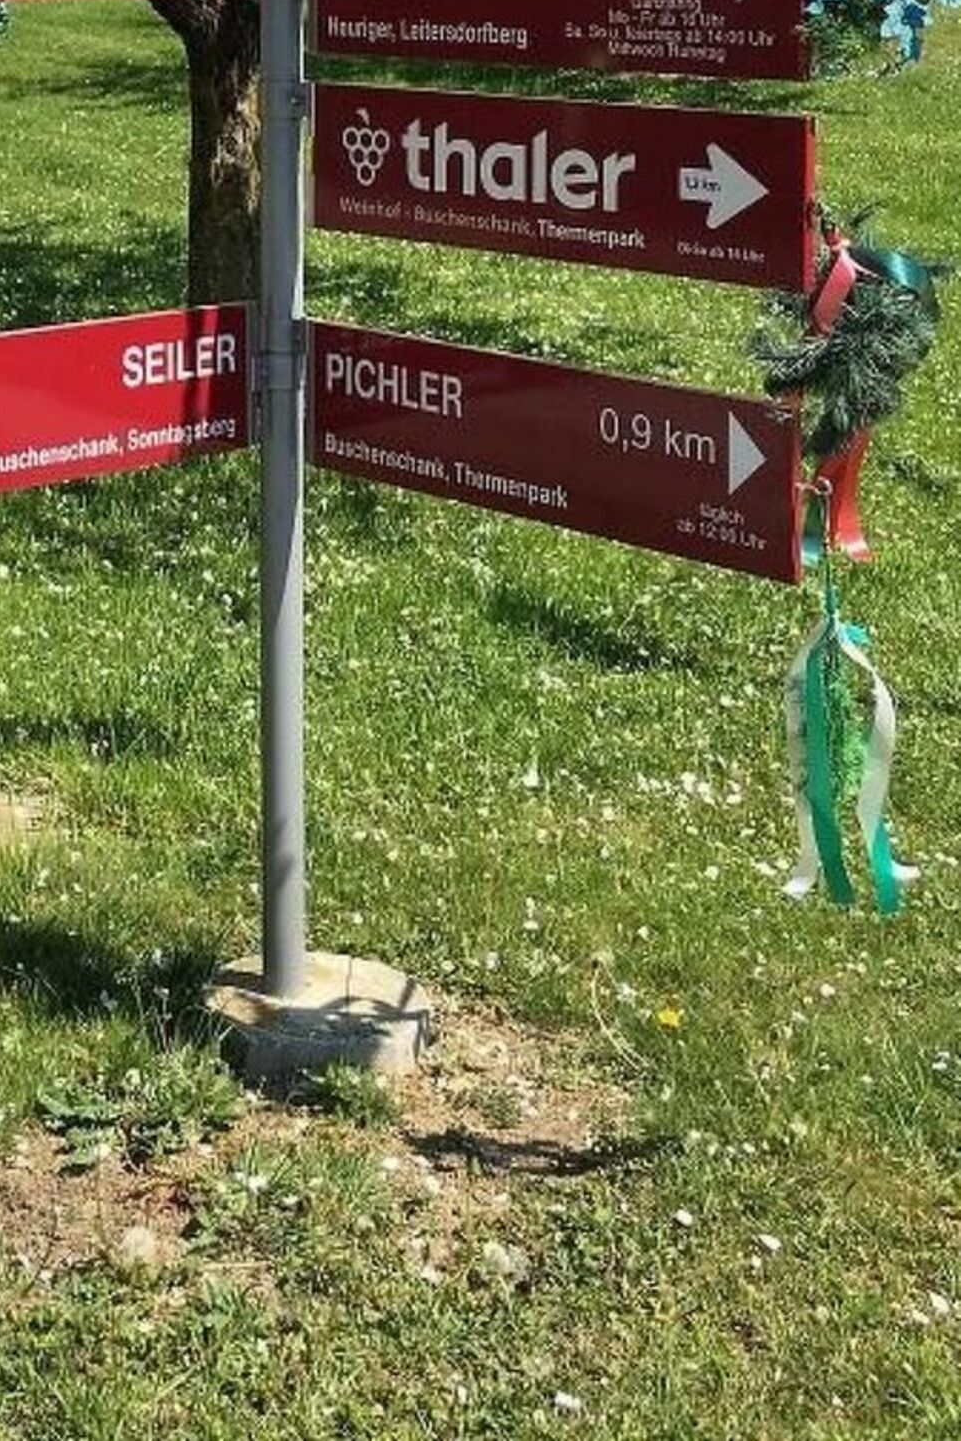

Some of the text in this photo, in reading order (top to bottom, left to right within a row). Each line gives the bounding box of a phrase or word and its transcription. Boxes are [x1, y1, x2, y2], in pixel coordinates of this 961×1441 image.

[400, 17, 528, 49] Leitersdorfberg
[401, 117, 637, 214] thaler
[339, 196, 401, 218] Weinhof
[538, 218, 646, 250] Thermenpark
[120, 333, 237, 390] SEILER
[325, 352, 463, 419] PICHLER
[126, 416, 237, 452] Sonntagsberg
[599, 407, 716, 465] 0,9 km
[454, 461, 569, 509] Thermenpark
